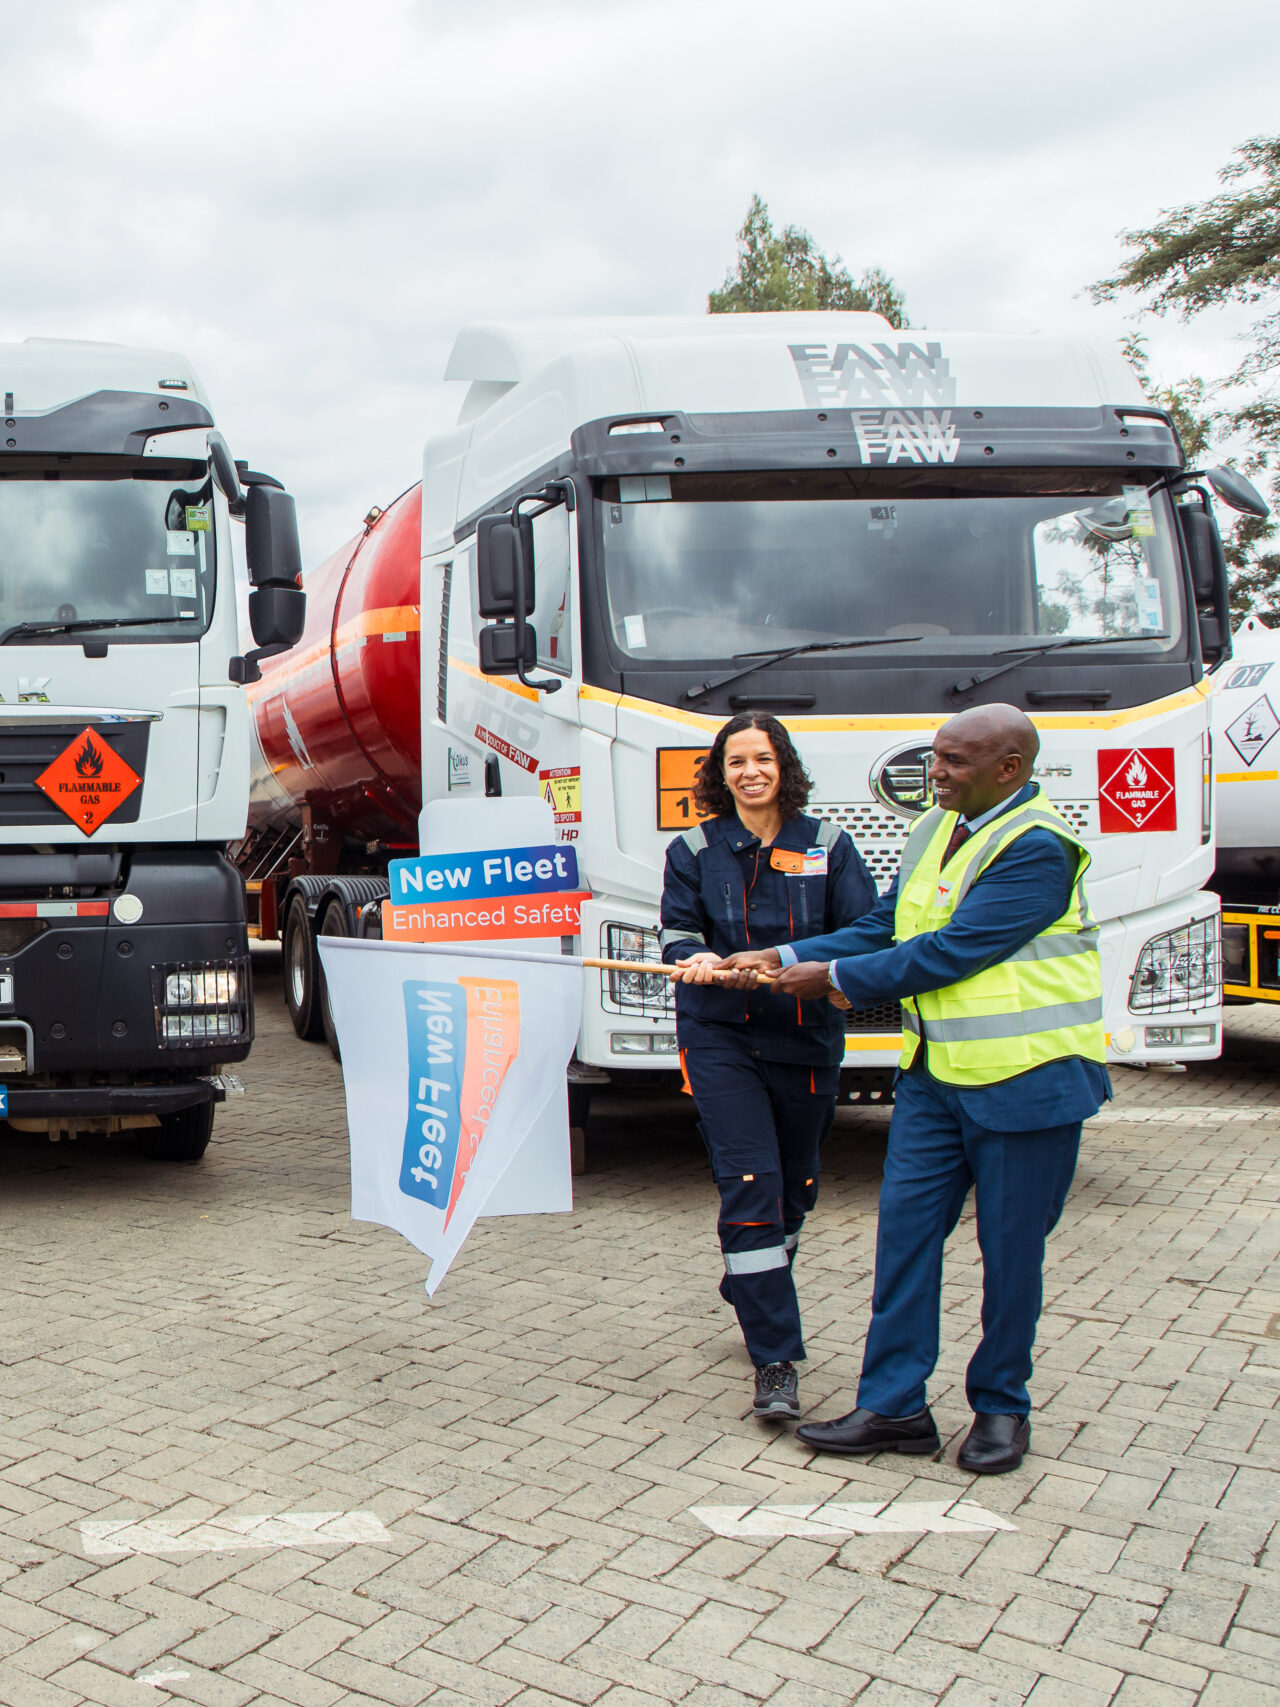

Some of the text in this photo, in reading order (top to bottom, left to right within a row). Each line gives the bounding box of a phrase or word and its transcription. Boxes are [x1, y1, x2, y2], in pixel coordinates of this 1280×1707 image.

[858, 437, 961, 464] FAW
[508, 745, 531, 769] FAW
[549, 769, 571, 778] ATTENTION
[58, 782, 121, 793] FLAMMABLE
[80, 794, 101, 805] GAS
[1116, 790, 1159, 800] FLAMMABLE
[1131, 799, 1147, 808] GAS
[84, 811, 94, 824] 2
[560, 813, 575, 822] SPOTS
[1135, 812, 1143, 823] 2
[399, 852, 568, 894] New Fleet
[393, 903, 582, 930] Enhanced Safety
